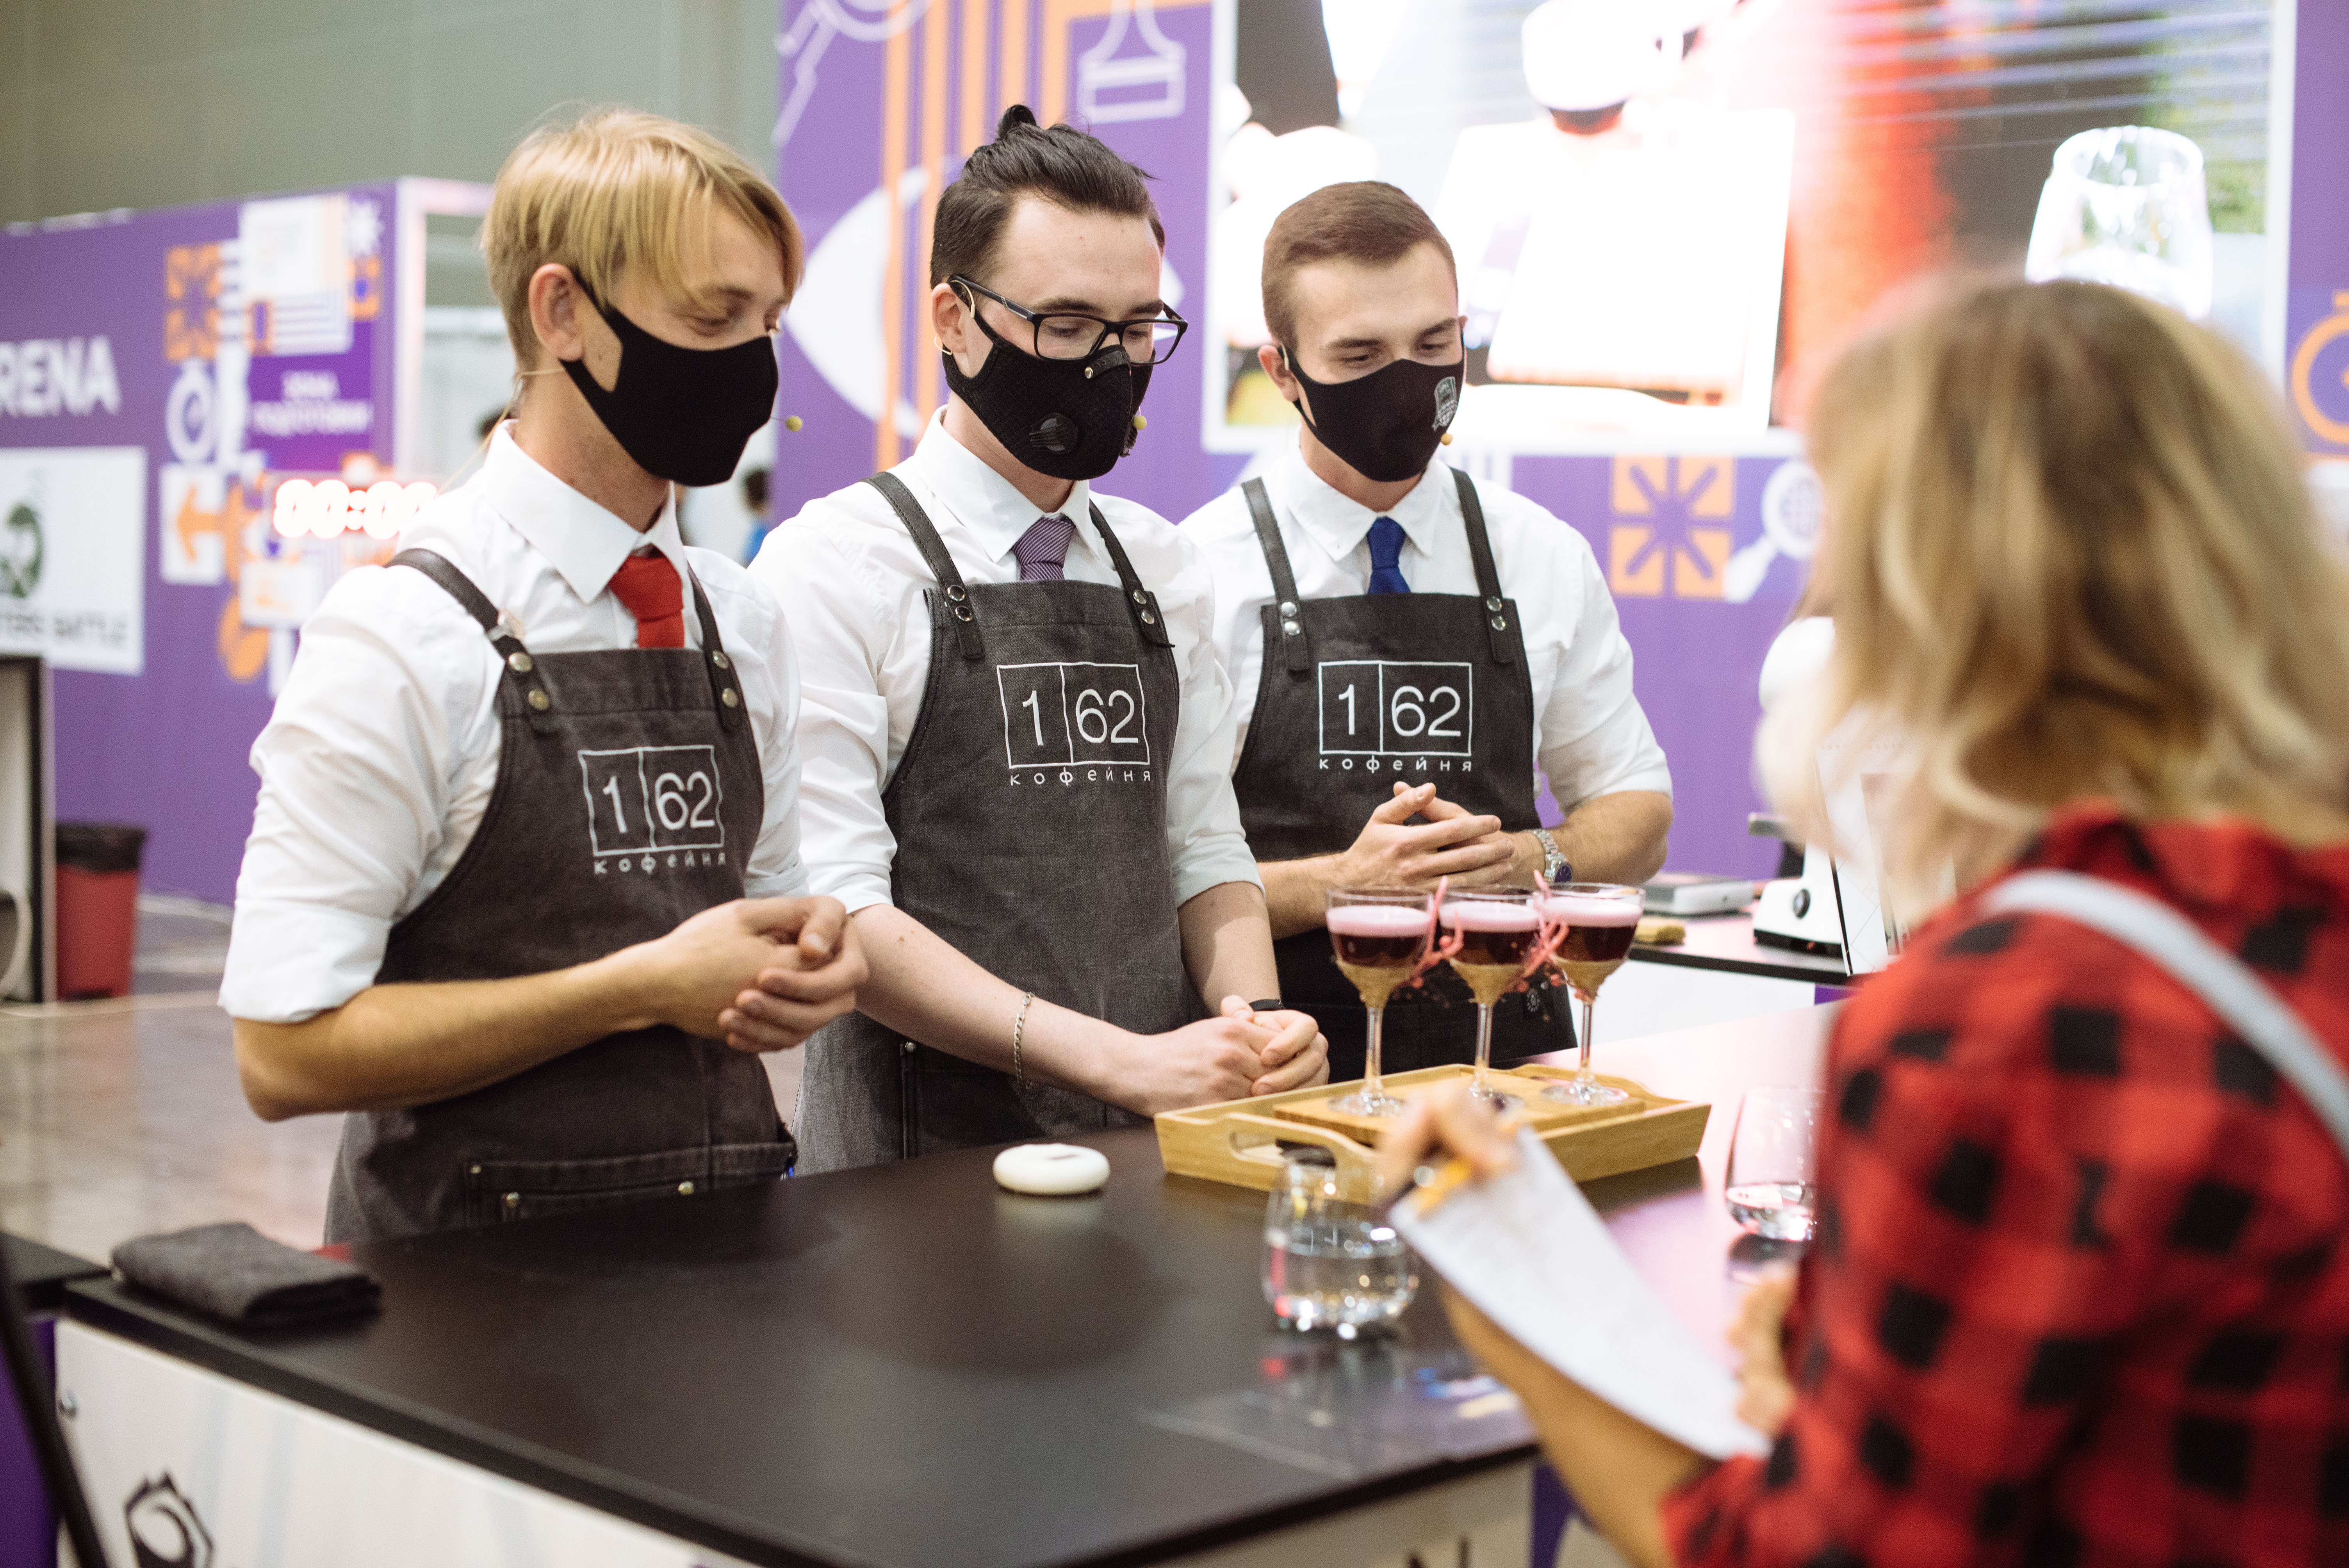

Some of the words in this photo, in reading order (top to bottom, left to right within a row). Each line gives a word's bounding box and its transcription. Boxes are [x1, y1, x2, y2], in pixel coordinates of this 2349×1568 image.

[1076, 689, 1139, 743] 62
[1391, 686, 1461, 737] 62
[1010, 767, 1150, 786] кофейня
[1319, 755, 1472, 773] кофейня
[655, 771, 715, 830] 62
[594, 850, 725, 875] кофейня
